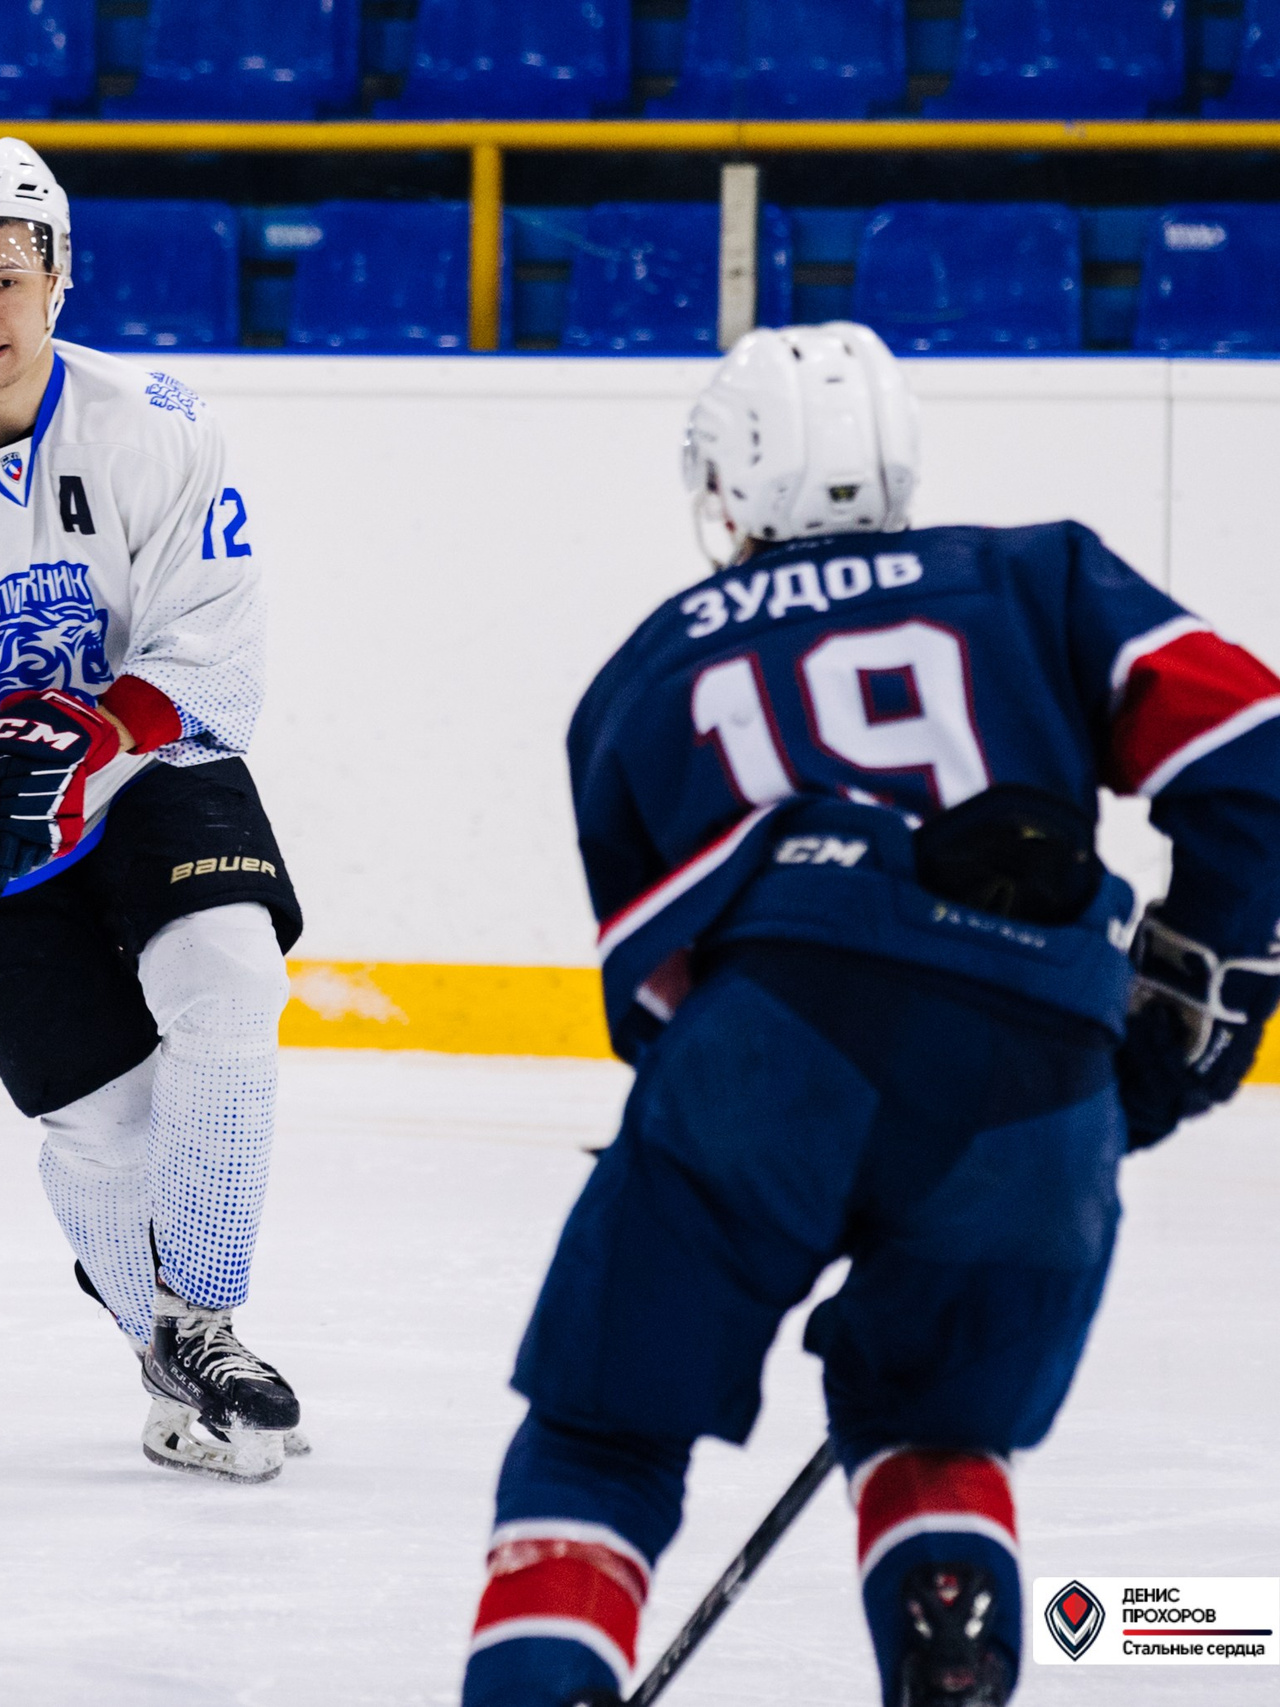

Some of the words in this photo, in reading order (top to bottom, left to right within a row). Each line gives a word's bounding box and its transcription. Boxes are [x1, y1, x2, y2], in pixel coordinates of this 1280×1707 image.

[58, 475, 96, 535] A
[201, 487, 252, 560] 12
[681, 552, 923, 639] ЗУДОВ
[691, 615, 992, 826] 19
